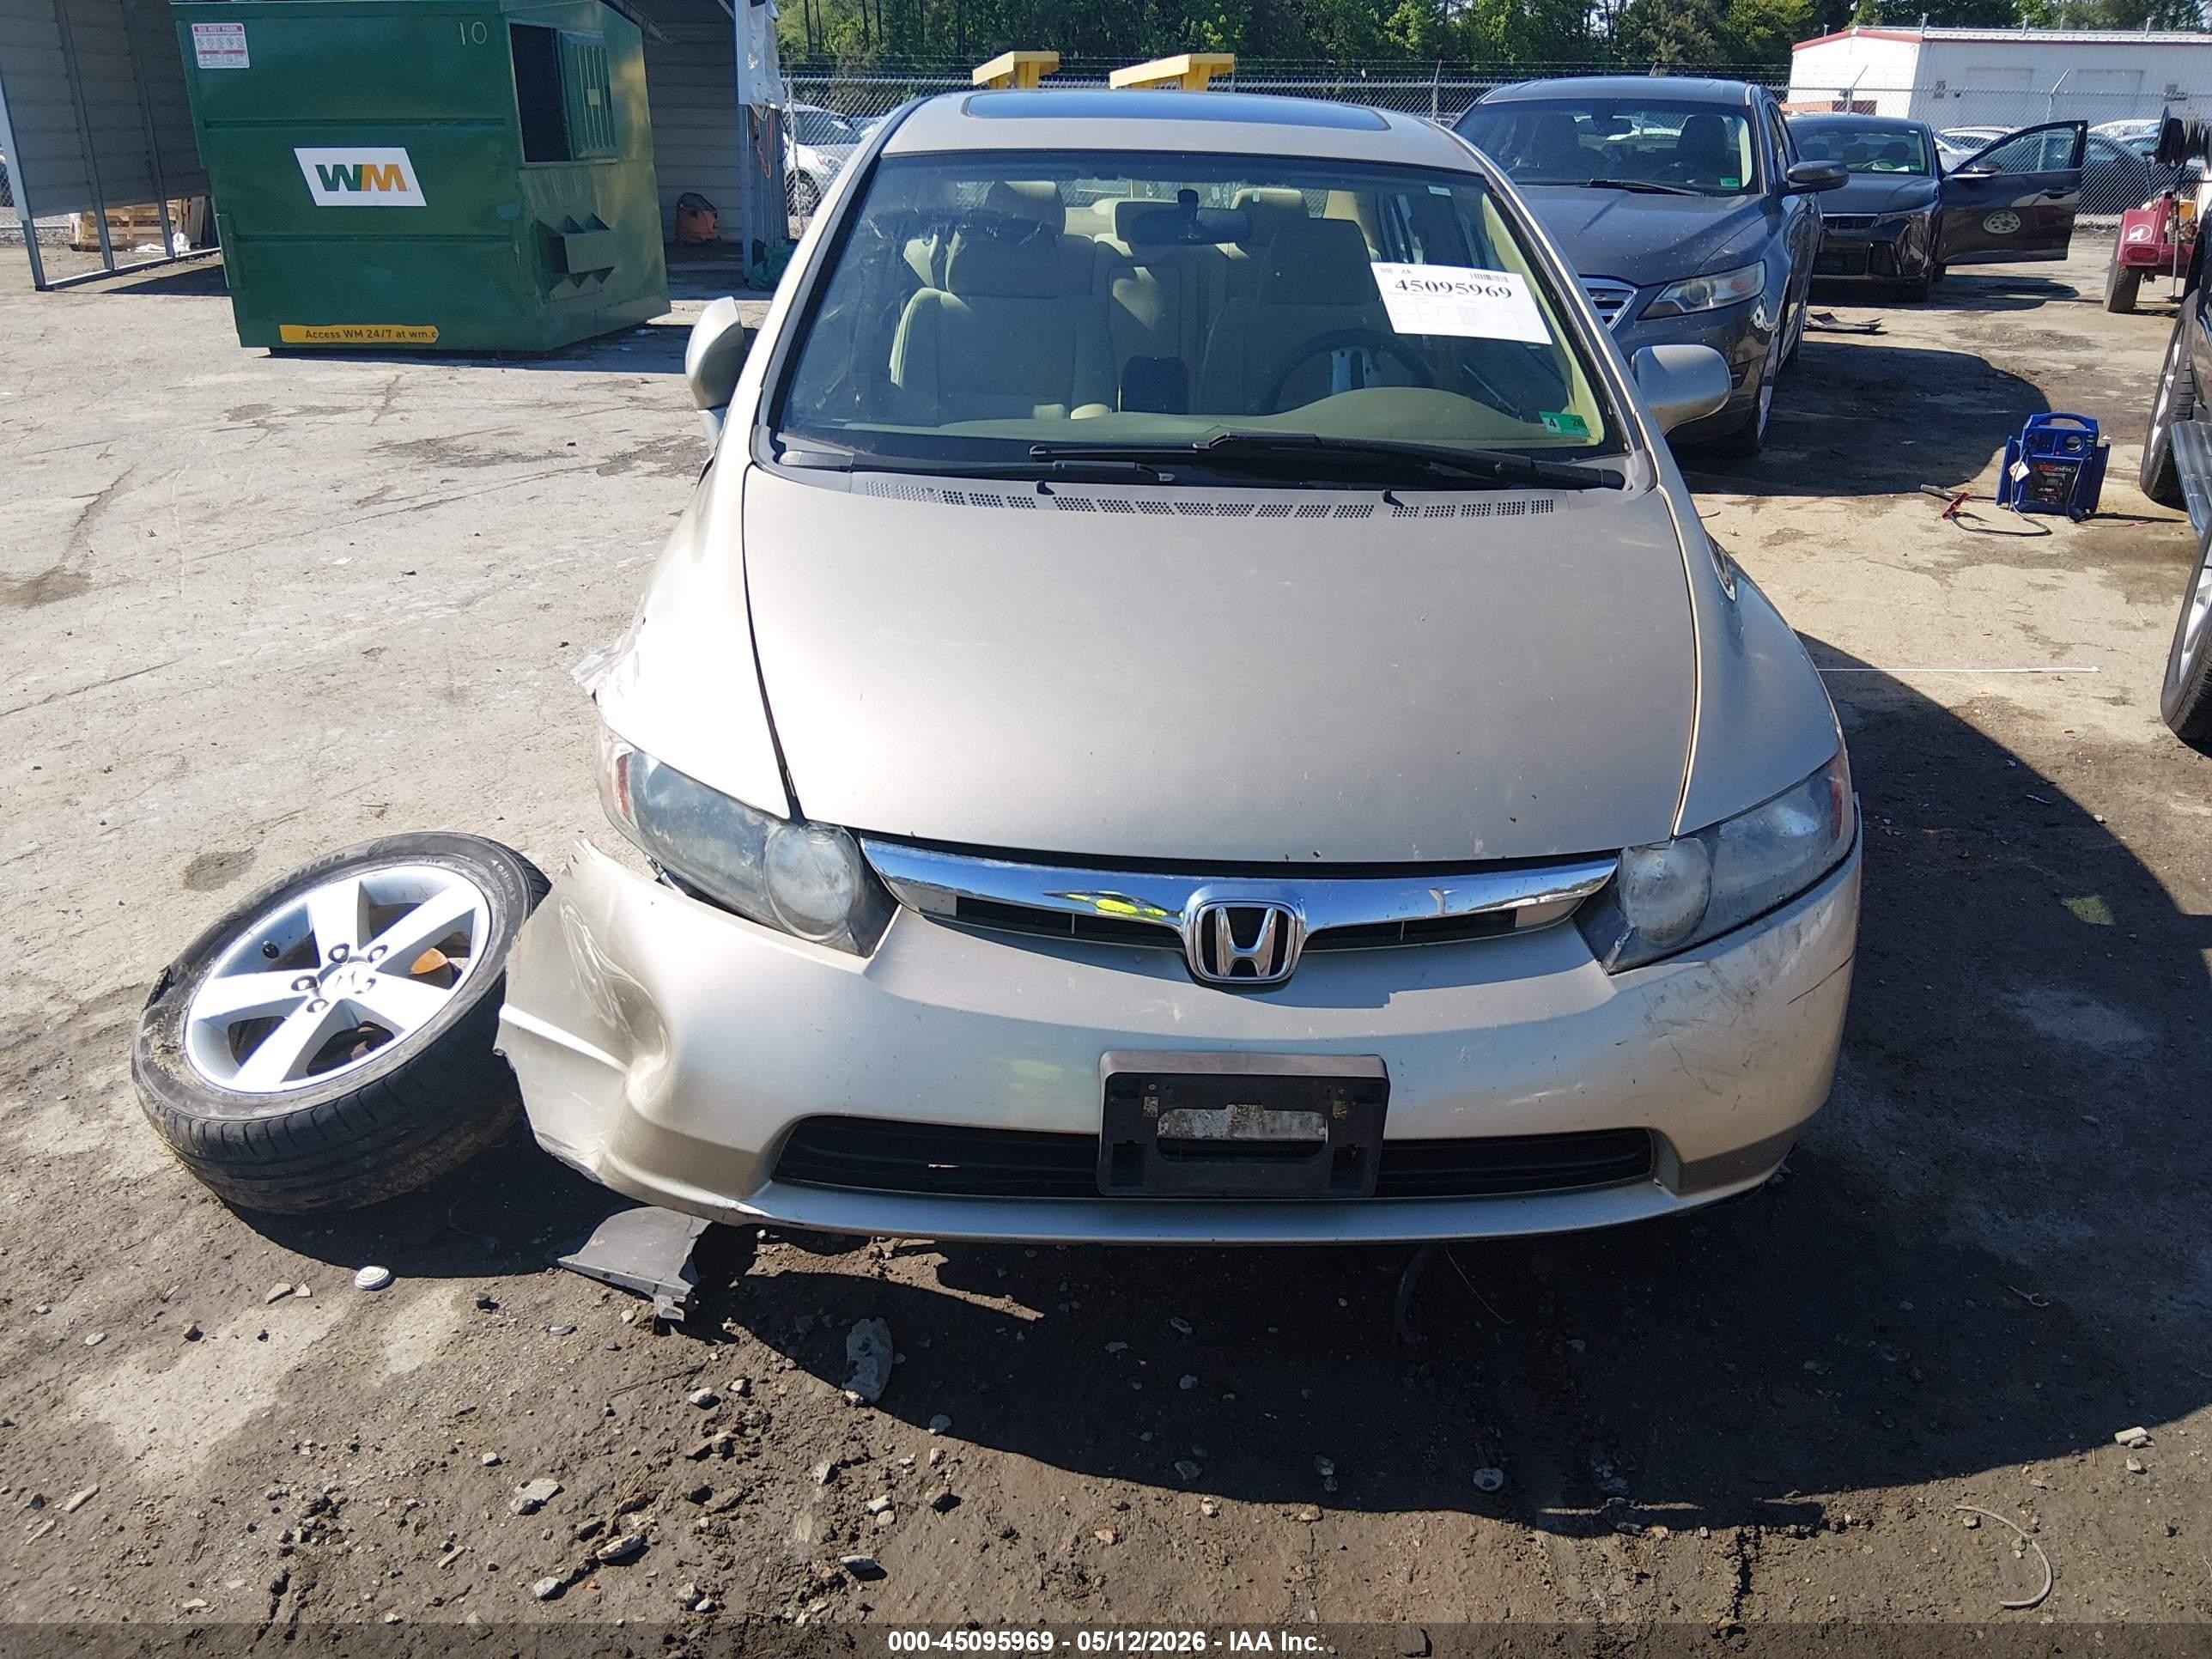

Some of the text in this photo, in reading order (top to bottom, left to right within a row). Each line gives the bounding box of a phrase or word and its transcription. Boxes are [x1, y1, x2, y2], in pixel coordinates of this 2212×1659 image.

[459, 21, 488, 46] 10
[314, 163, 409, 192] WM
[1395, 278, 1513, 300] 45095969
[305, 329, 341, 339] Access
[343, 329, 363, 338] WM
[367, 329, 392, 338] 24/7
[396, 330, 405, 338] at
[1549, 417, 1557, 428] 4
